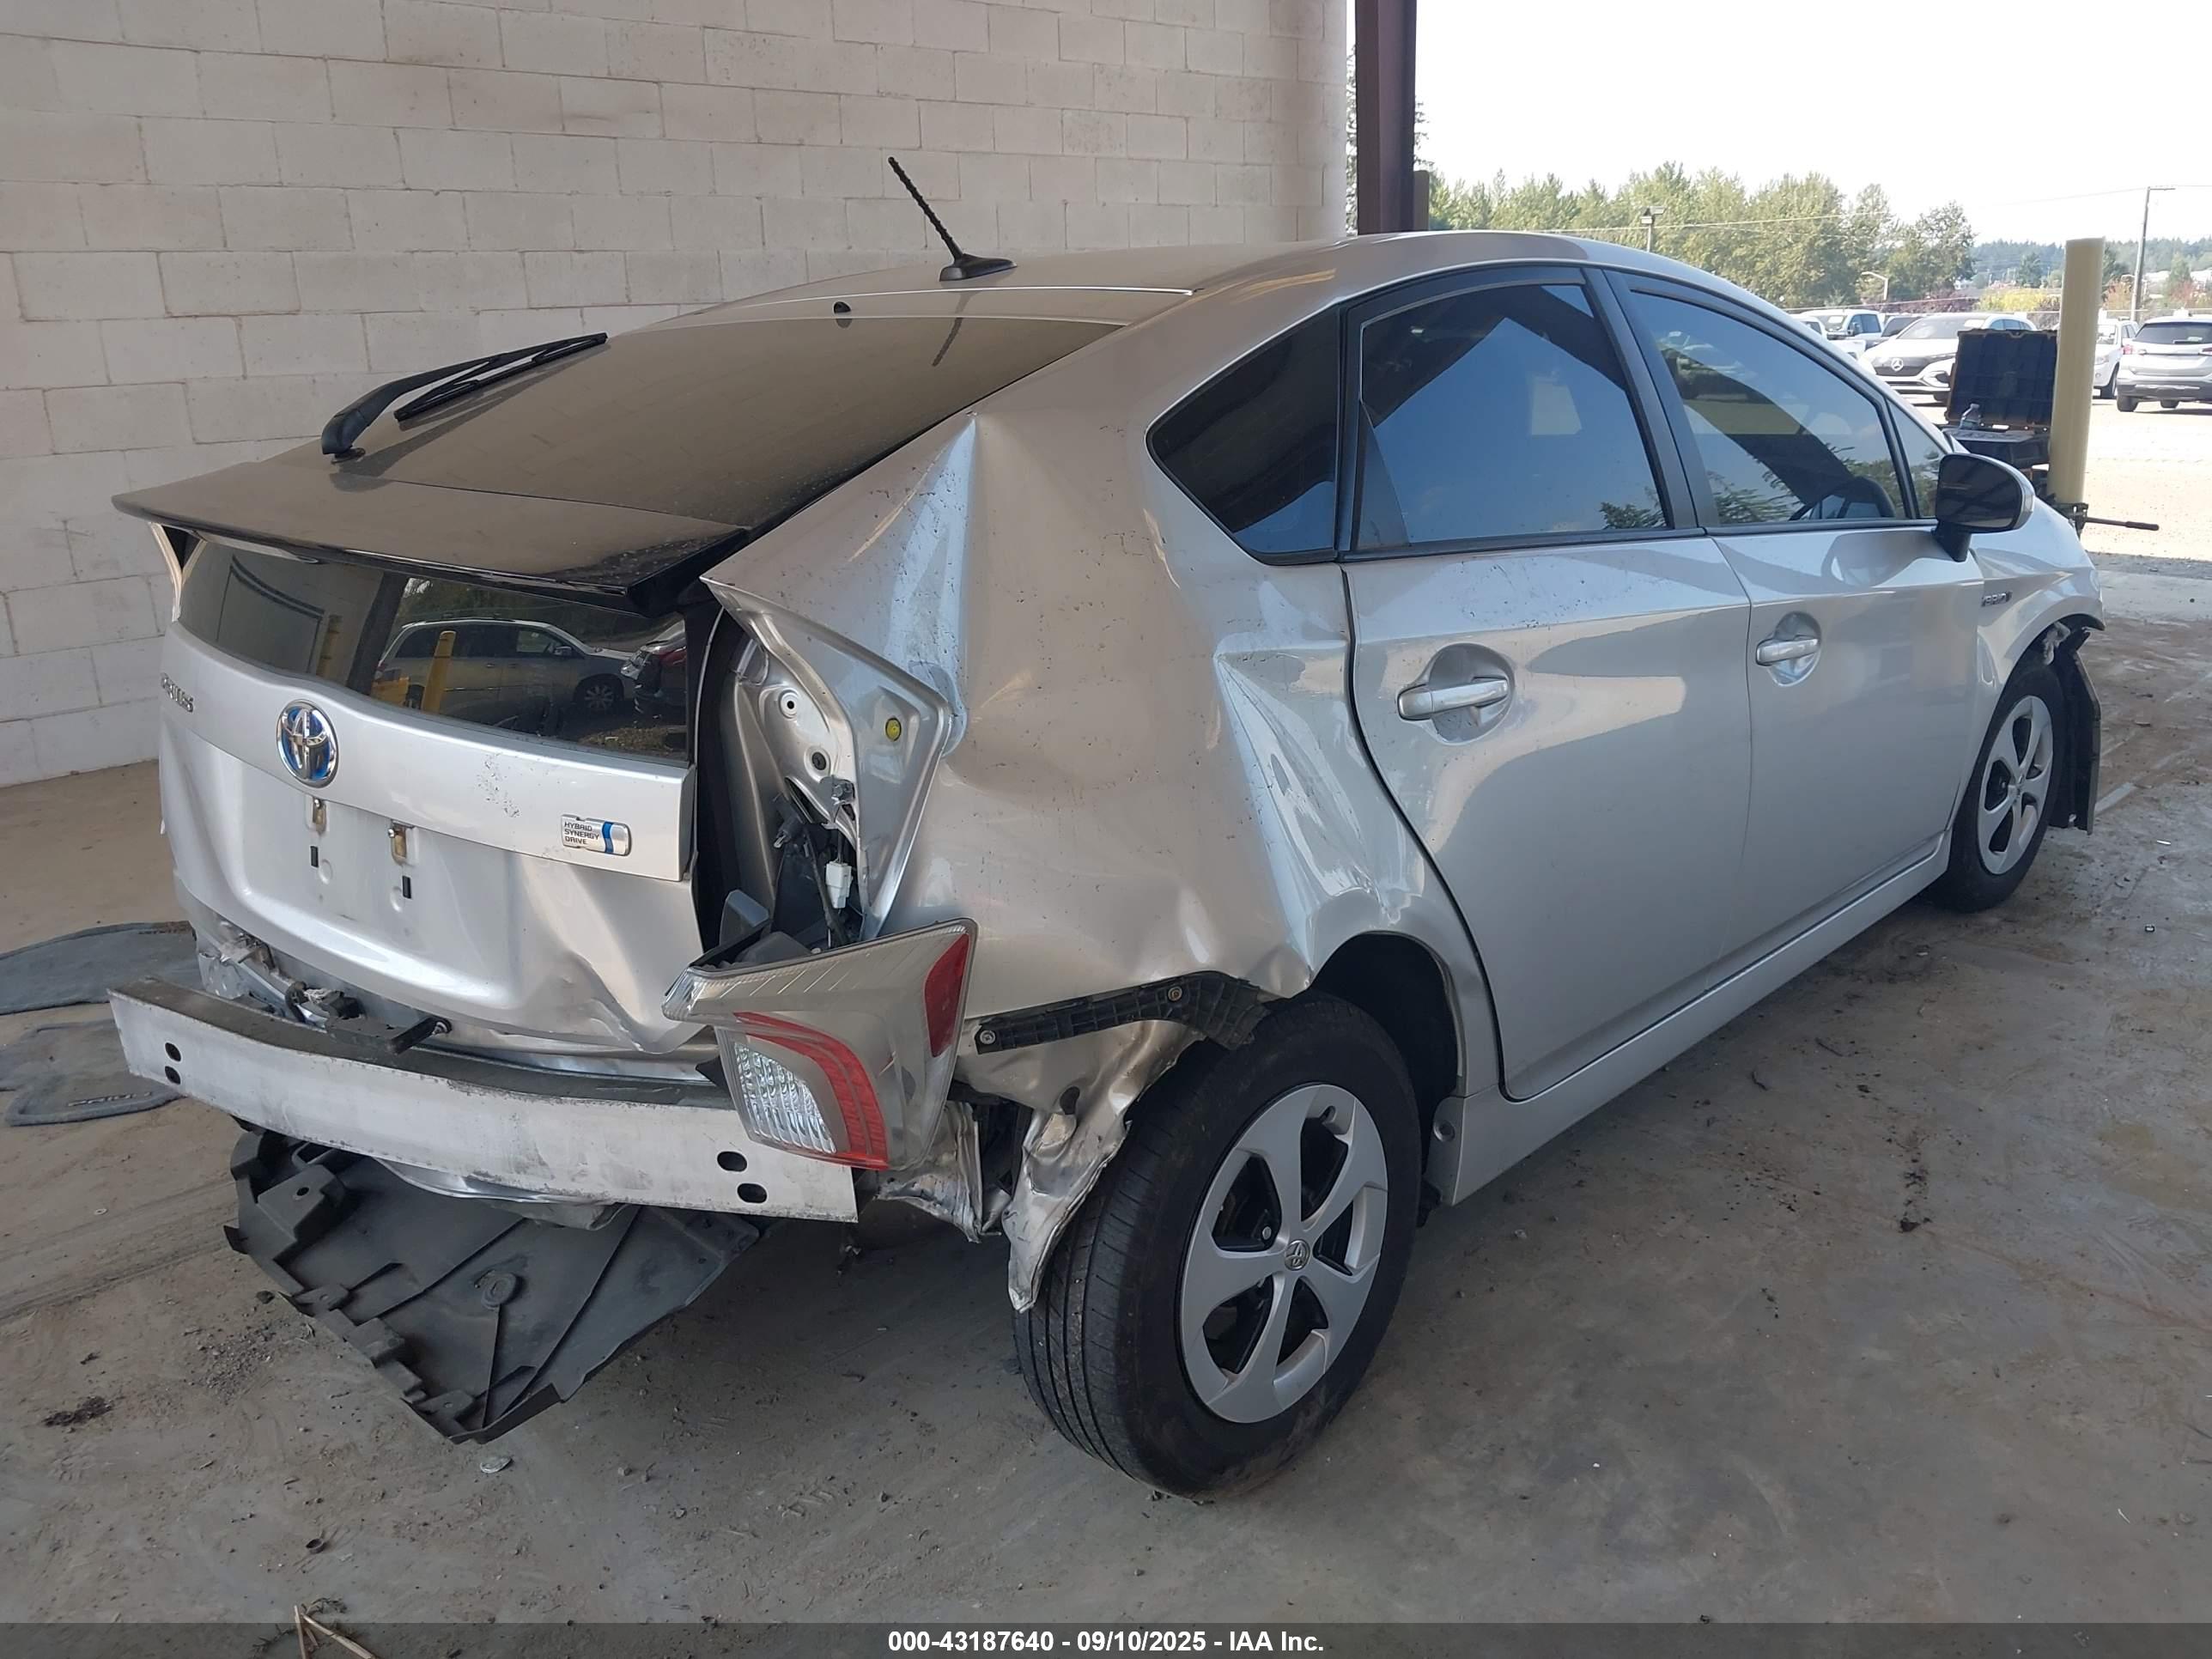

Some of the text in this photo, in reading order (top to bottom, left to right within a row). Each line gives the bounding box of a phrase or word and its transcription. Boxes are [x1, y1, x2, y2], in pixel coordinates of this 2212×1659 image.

[564, 821, 592, 832] HYBRID
[564, 829, 599, 840] SYNERGY
[564, 836, 587, 845] DRIVE
